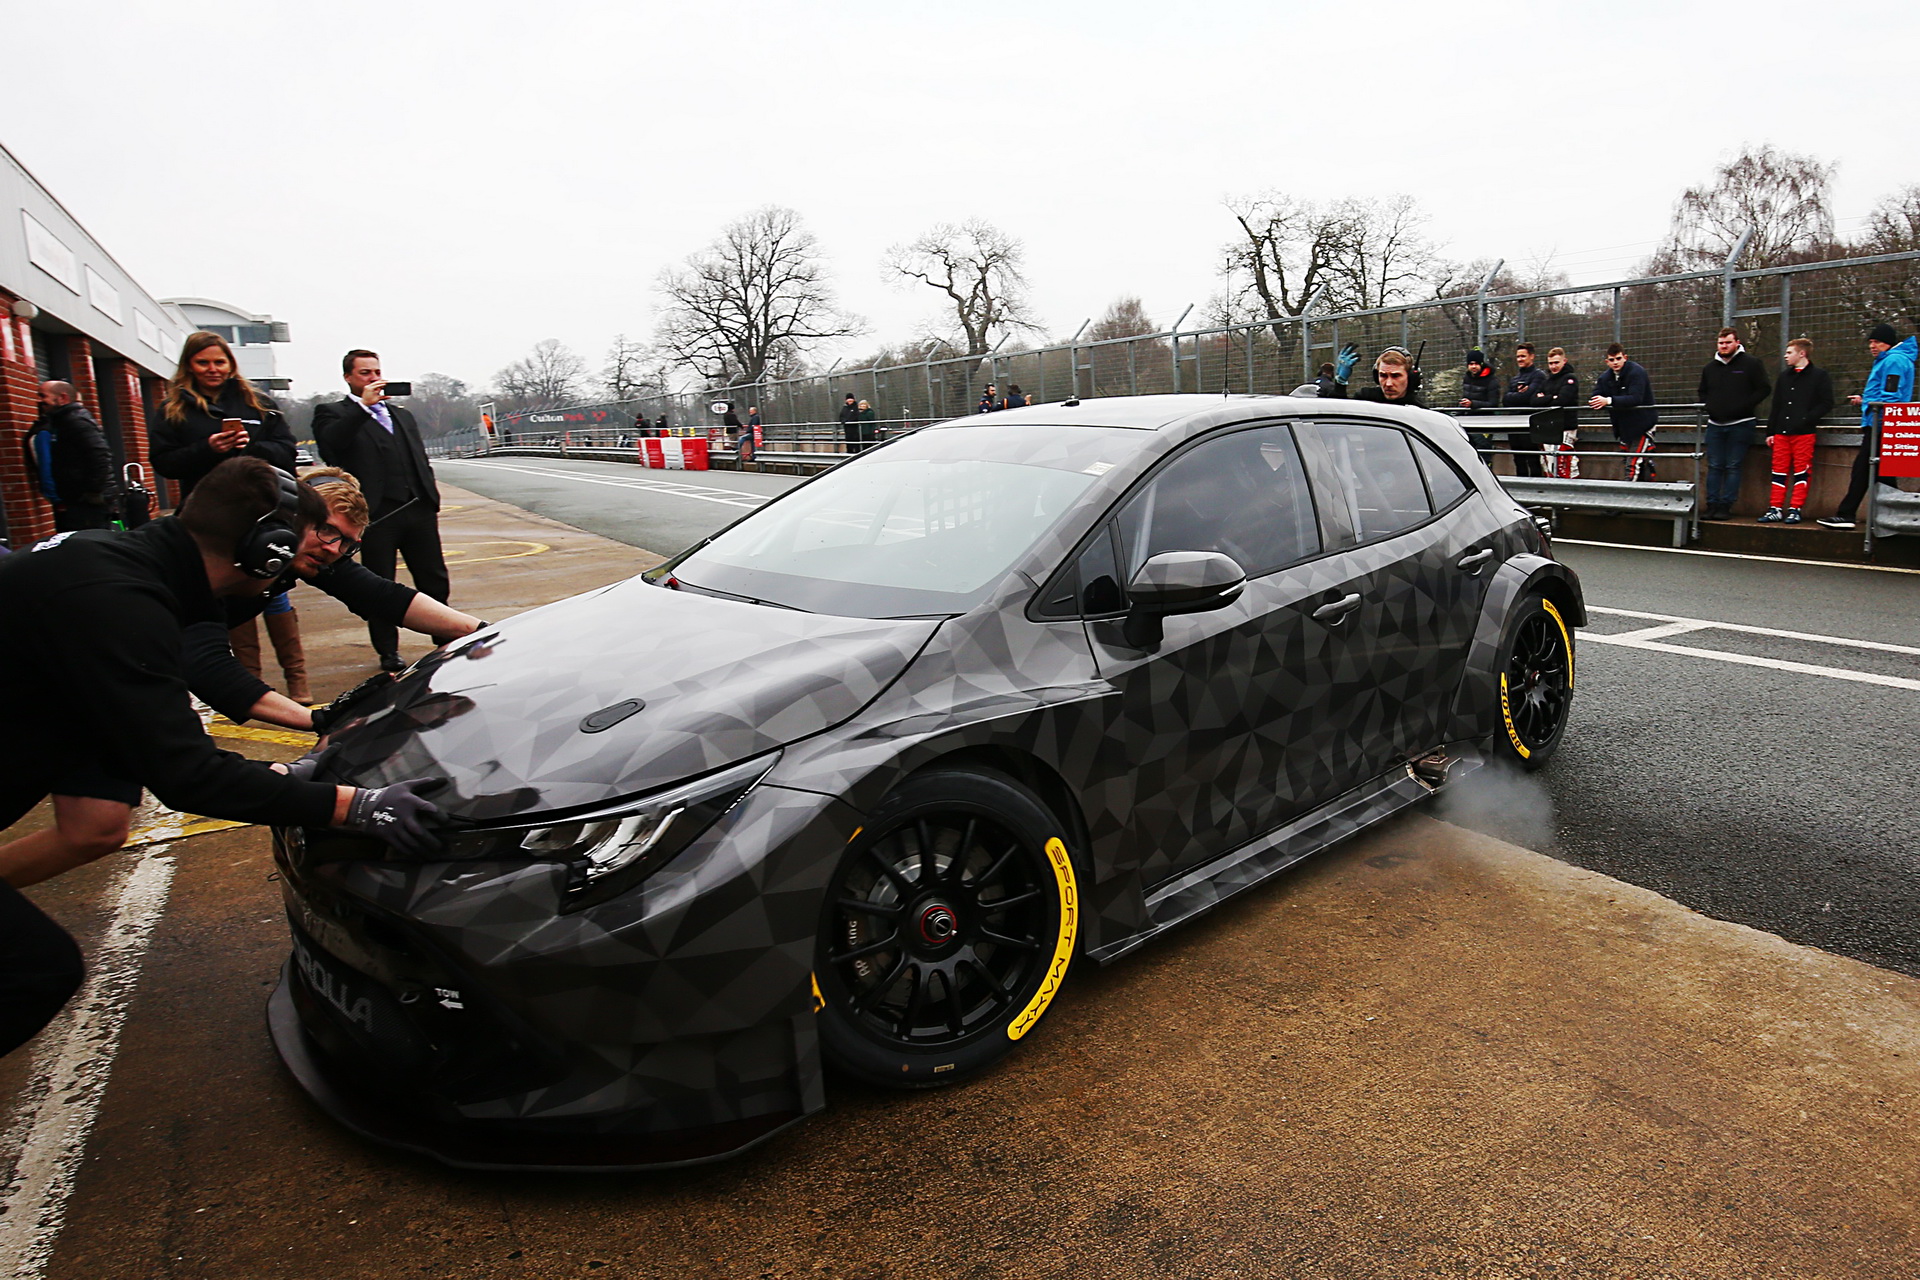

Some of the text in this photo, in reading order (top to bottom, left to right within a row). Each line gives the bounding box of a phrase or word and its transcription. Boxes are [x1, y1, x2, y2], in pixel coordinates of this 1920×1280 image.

[1885, 406, 1903, 416] Pit
[1894, 443, 1919, 451] Sitting
[1051, 846, 1075, 947] SPORT
[433, 987, 460, 999] TOW
